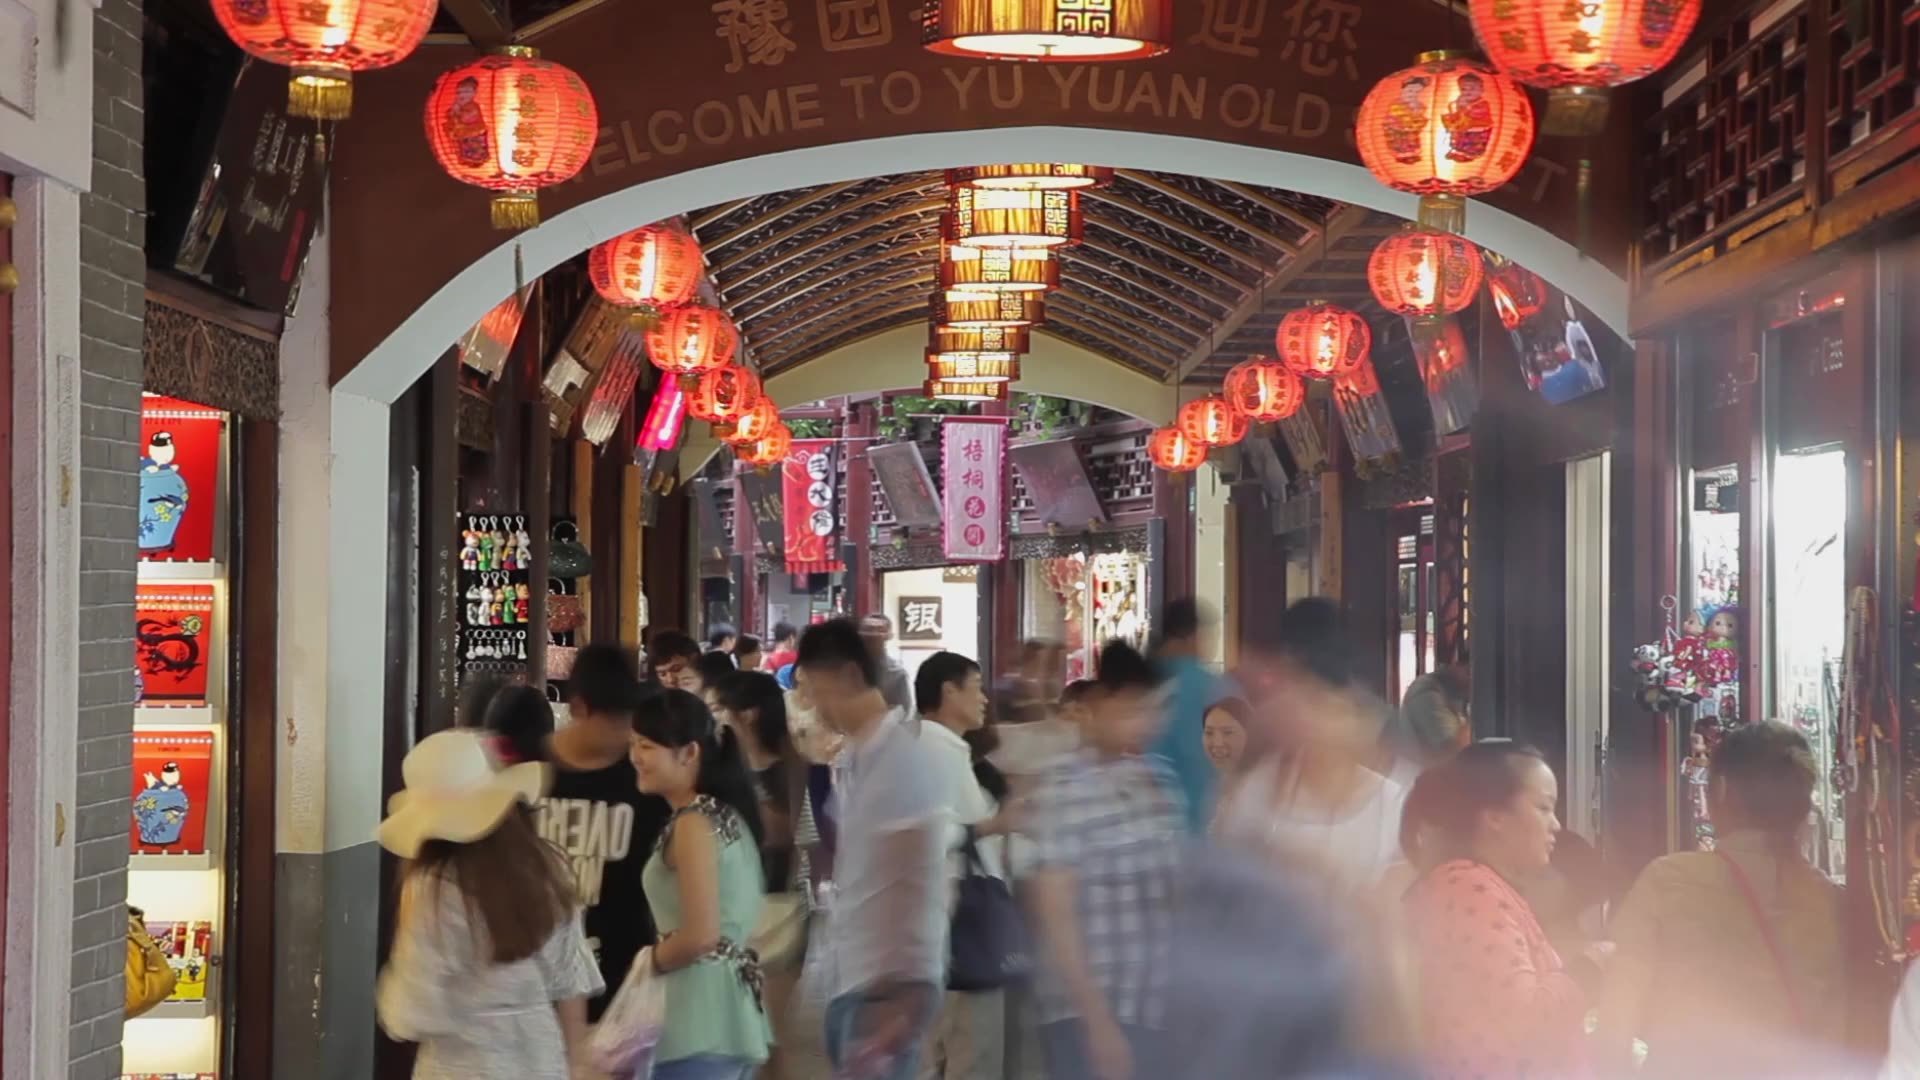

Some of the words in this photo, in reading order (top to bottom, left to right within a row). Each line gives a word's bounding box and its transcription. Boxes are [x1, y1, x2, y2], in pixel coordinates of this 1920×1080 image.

[574, 83, 825, 184] ELCOME
[840, 70, 921, 120] TO
[943, 64, 1023, 111] YU
[1046, 64, 1208, 120] YUAN
[1219, 82, 1331, 139] OLD
